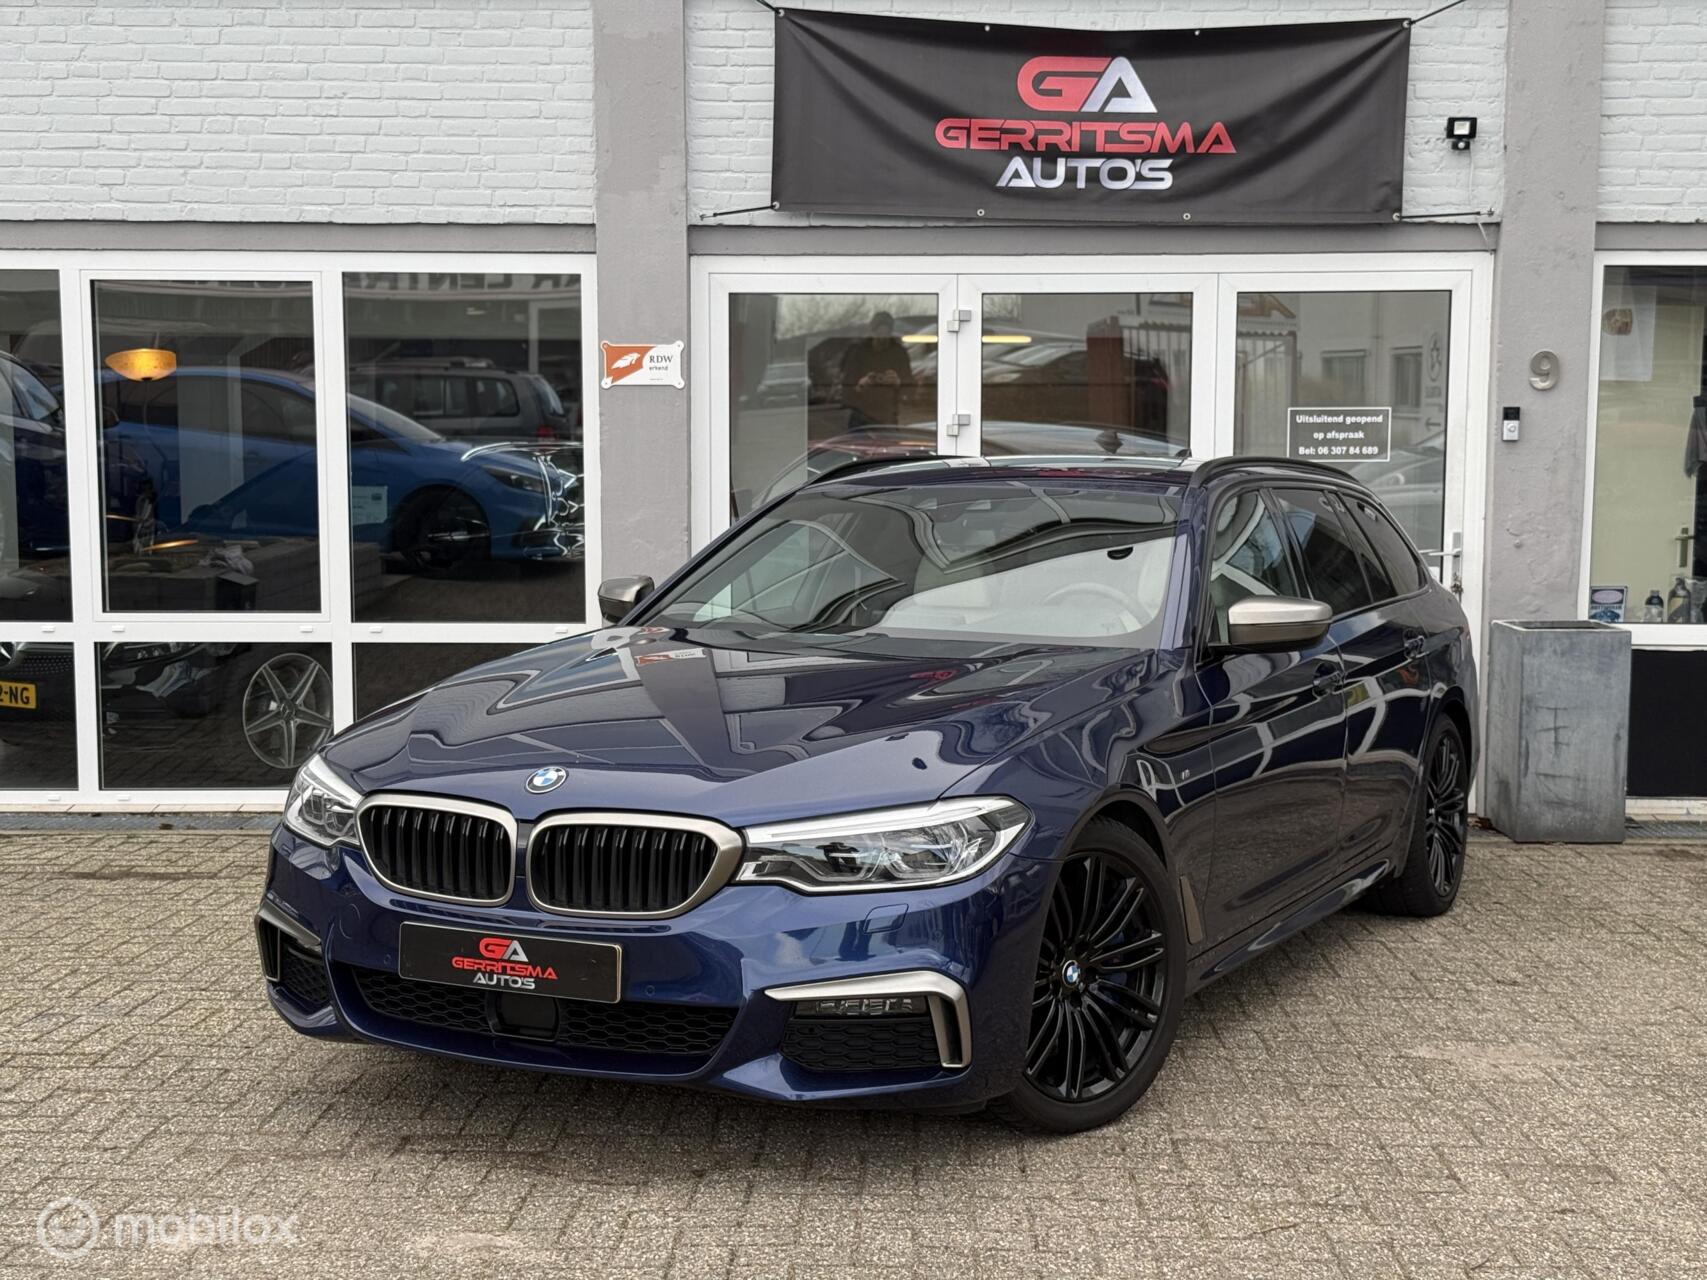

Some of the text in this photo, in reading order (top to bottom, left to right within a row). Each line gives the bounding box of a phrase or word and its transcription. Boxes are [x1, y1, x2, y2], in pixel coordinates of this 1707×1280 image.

[1016, 56, 1158, 113] GA
[934, 117, 1238, 154] GERRITSMA
[995, 156, 1174, 190] AUTO'S
[649, 355, 673, 363] RDW
[1529, 349, 1560, 391] 9
[1296, 415, 1383, 425] Uitsluitend geopend
[1313, 430, 1365, 440] op afspraak
[1298, 446, 1316, 455] Bel:
[1317, 446, 1329, 455] 06
[1330, 446, 1347, 455] 307
[479, 937, 529, 962] GA
[451, 956, 558, 980] GERRITSMA
[473, 972, 536, 990] AUTO'S
